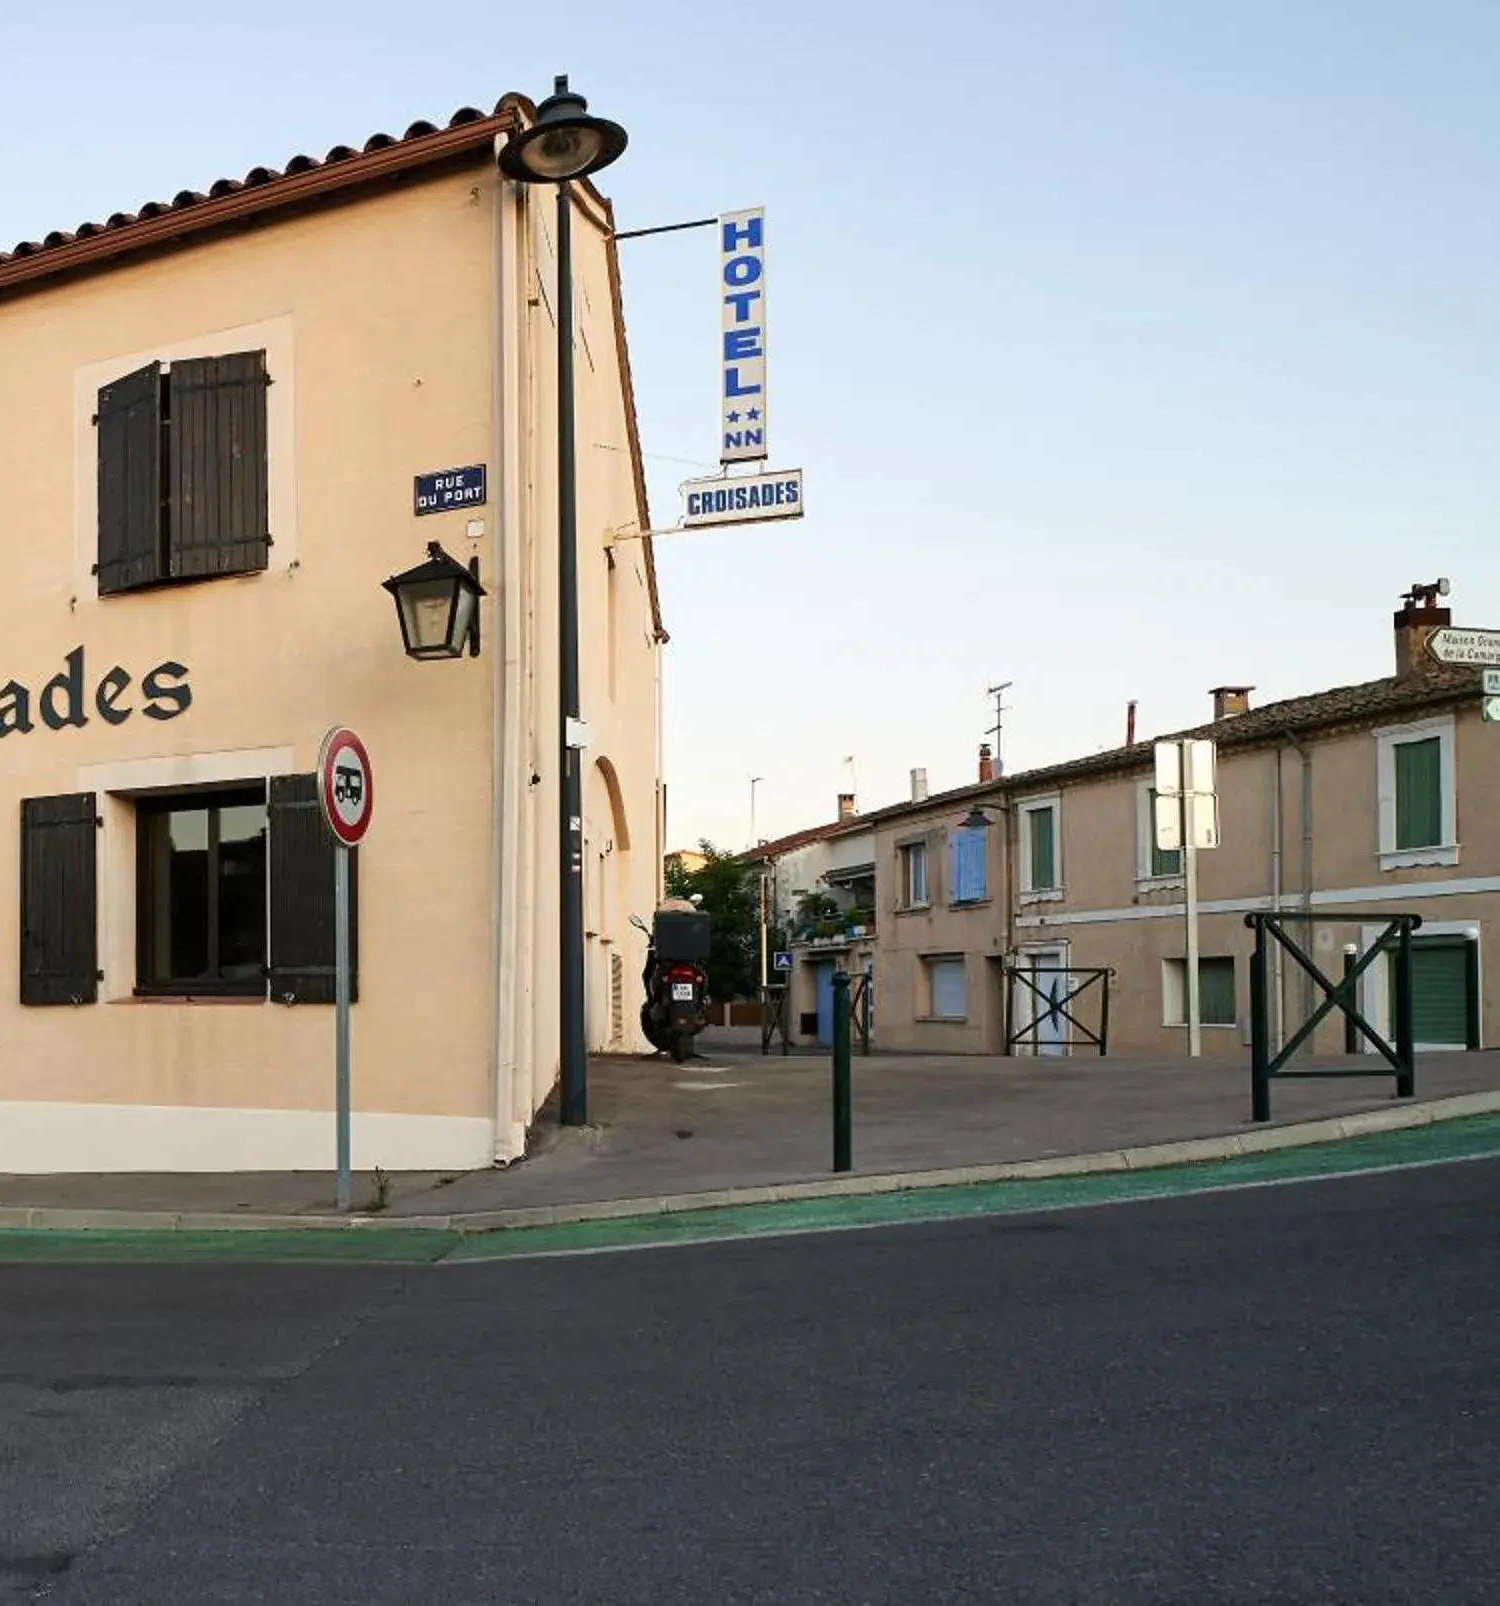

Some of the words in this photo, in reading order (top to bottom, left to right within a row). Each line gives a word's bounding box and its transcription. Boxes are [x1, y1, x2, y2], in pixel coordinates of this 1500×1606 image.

[722, 217, 763, 397] HOTEL
[725, 430, 763, 448] NN
[435, 474, 465, 491] RUE
[418, 494, 437, 508] DU
[444, 486, 483, 503] PORT
[688, 480, 800, 516] CROISADES
